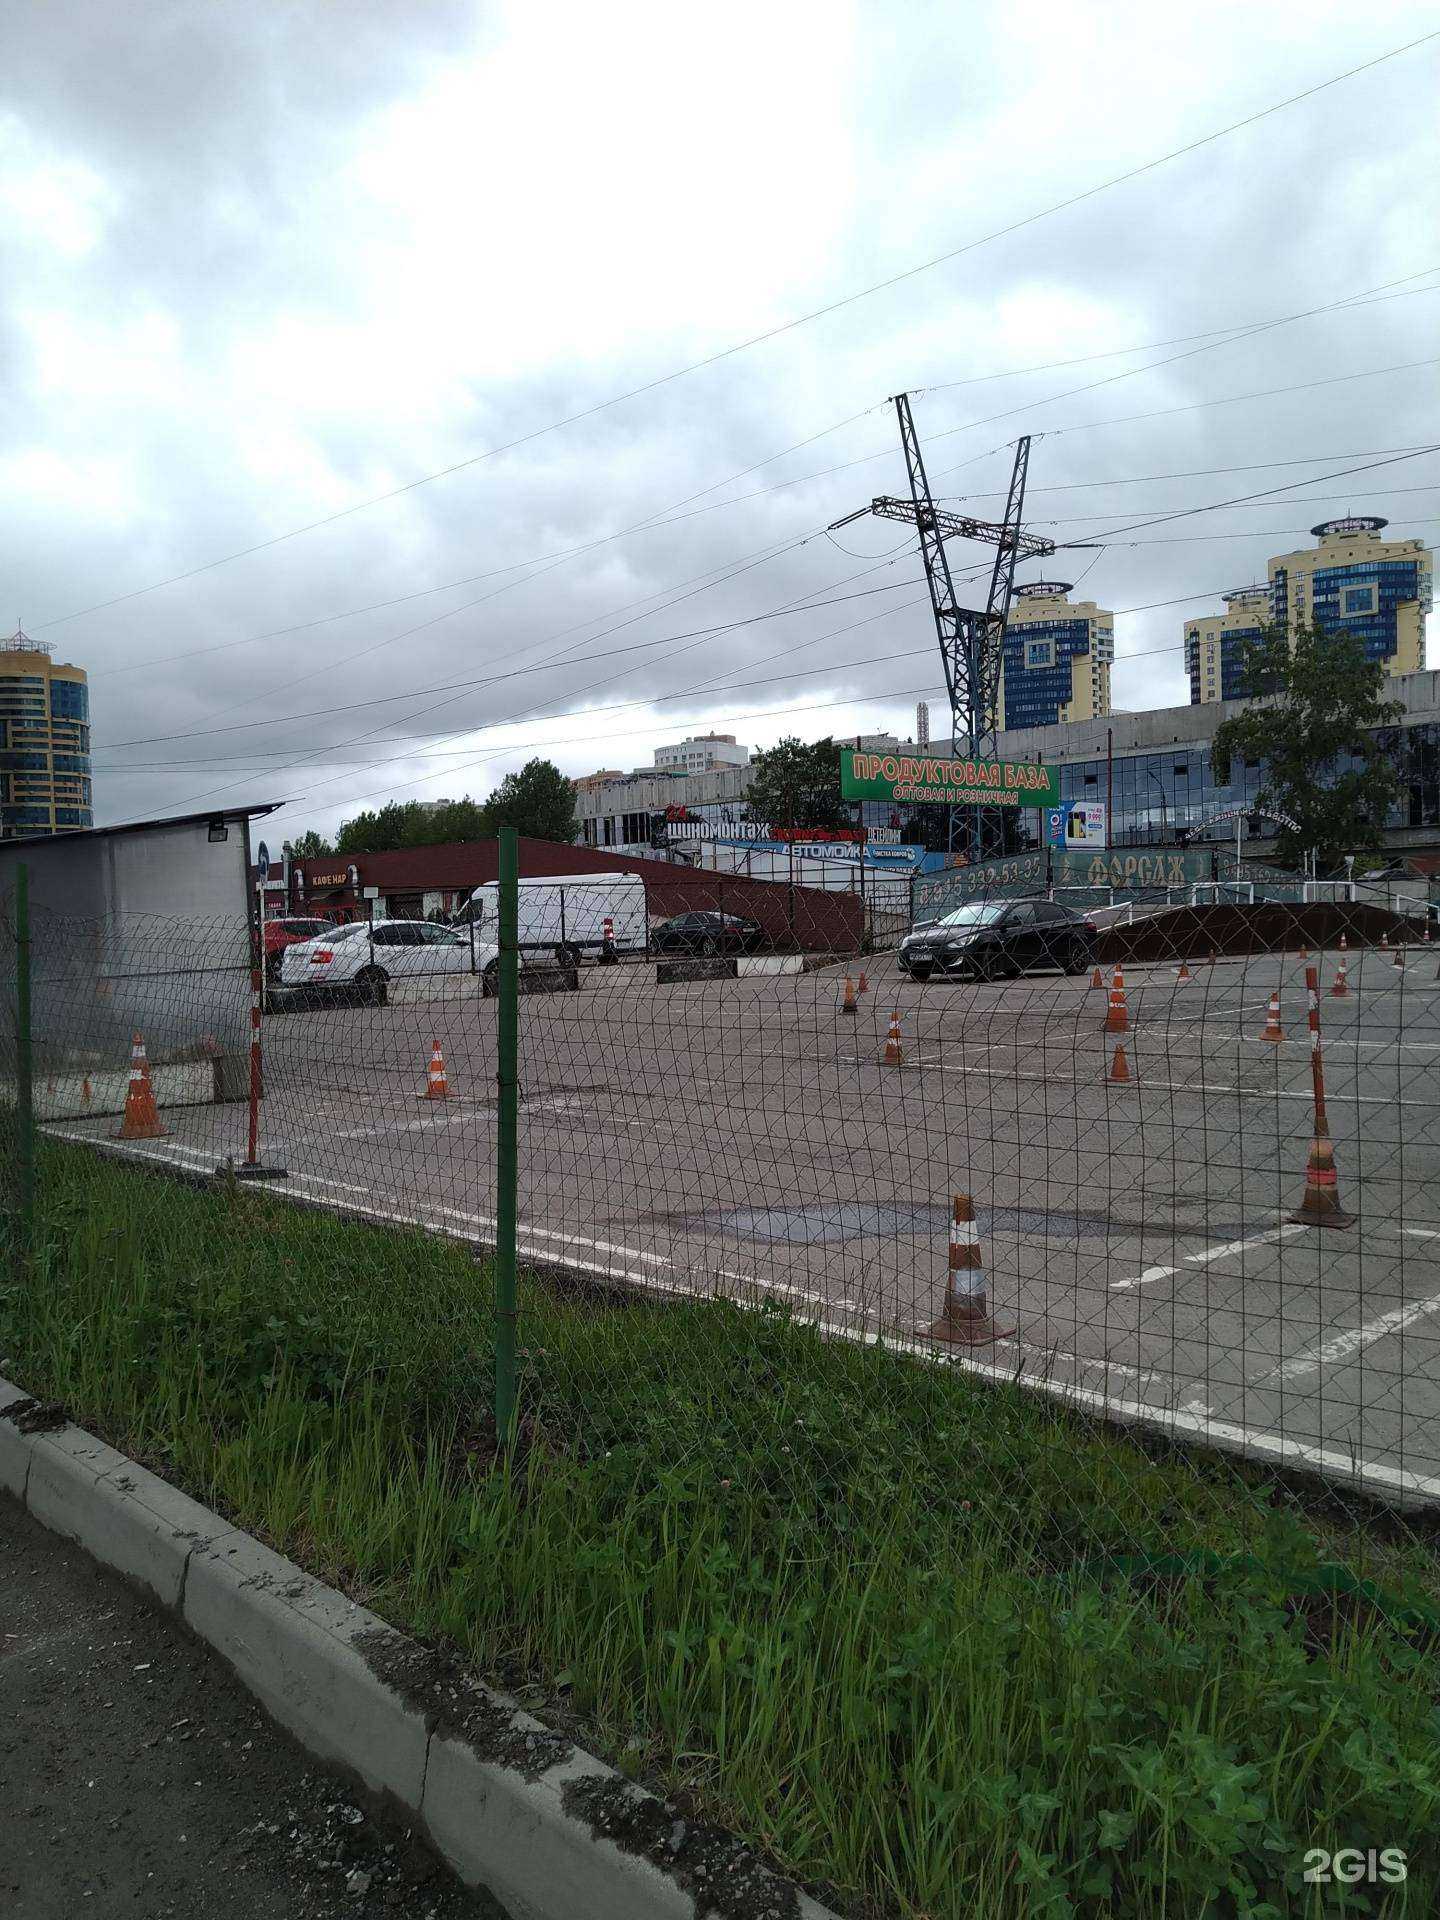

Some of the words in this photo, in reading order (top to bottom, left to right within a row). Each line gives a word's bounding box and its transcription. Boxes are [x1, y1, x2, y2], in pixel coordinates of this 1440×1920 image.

[852, 754, 1001, 787] ПРОДУКТОВАЯ
[1004, 763, 1051, 790] БАЗА
[892, 785, 945, 801] ОПТОВАЯ
[946, 788, 954, 802] И
[956, 790, 1019, 805] РОЗНИЧНАЯ
[666, 805, 688, 821] 24
[781, 844, 871, 858] АВТОМОЙКА
[312, 875, 332, 886] КАФЕ
